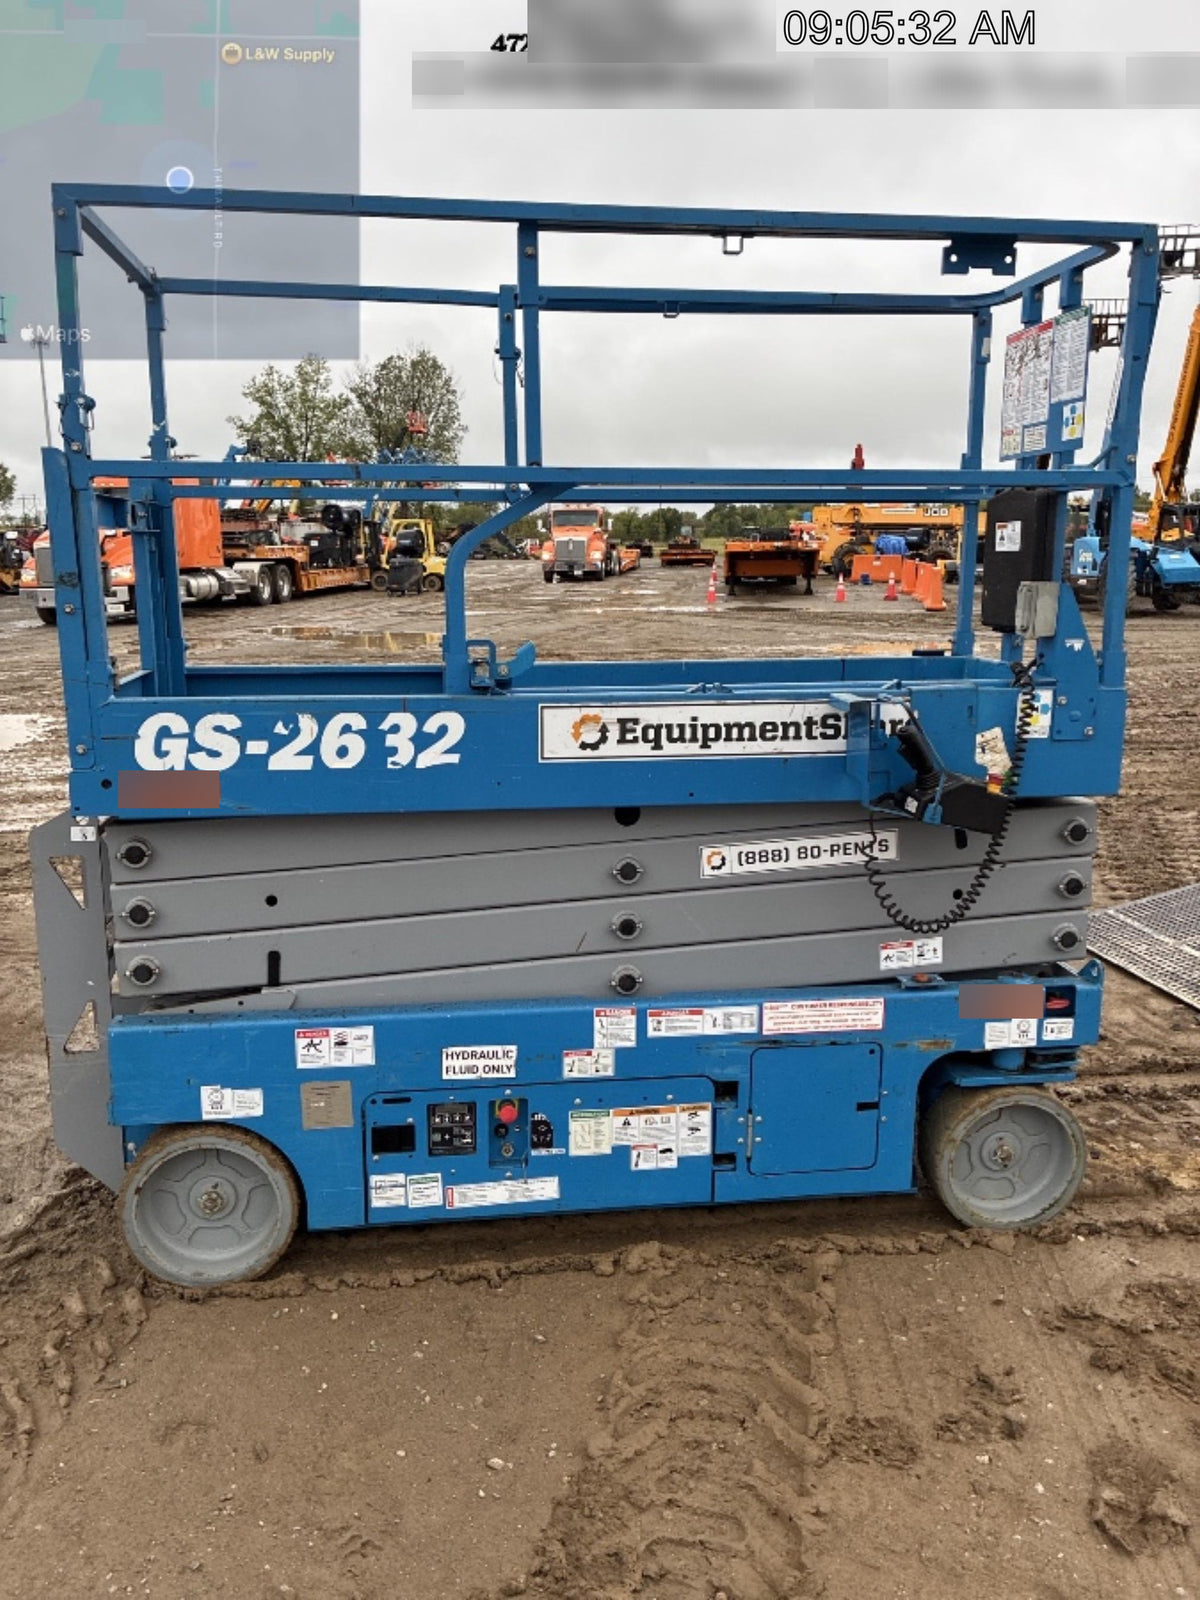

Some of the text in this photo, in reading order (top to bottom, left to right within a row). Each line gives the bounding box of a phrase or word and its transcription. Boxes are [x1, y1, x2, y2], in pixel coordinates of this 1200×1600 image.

[738, 847, 790, 867] (888)
[445, 1049, 514, 1060] HYDRAULIC
[445, 1064, 513, 1075] FLUID ONLY
